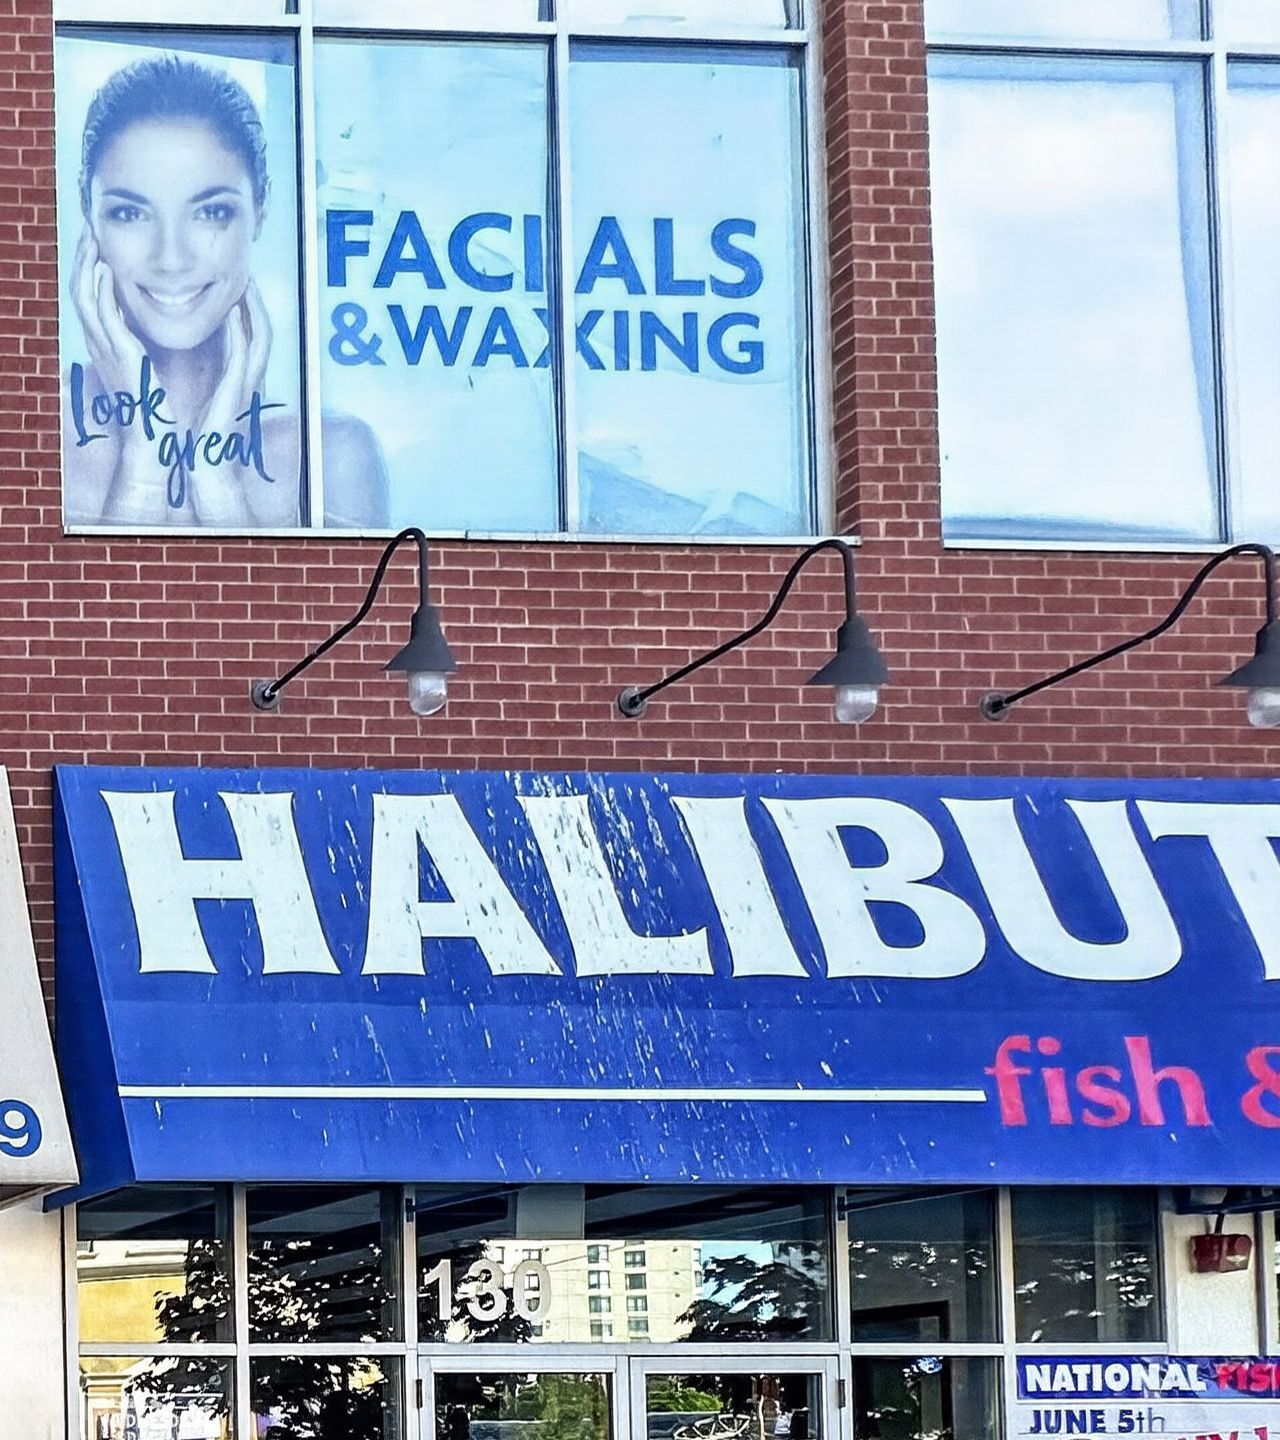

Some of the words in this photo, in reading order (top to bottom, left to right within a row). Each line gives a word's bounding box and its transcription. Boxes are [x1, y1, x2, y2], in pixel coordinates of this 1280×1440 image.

[324, 209, 764, 299] FACIALS
[70, 355, 177, 447] Look
[158, 391, 287, 508] great
[98, 788, 1280, 981] HALIBUT
[985, 1035, 1212, 1129] fish
[424, 1259, 551, 1321] 130
[1025, 1363, 1206, 1391] NATIONAL
[1030, 1410, 1107, 1434] JUNE
[1118, 1407, 1165, 1434] 5th
